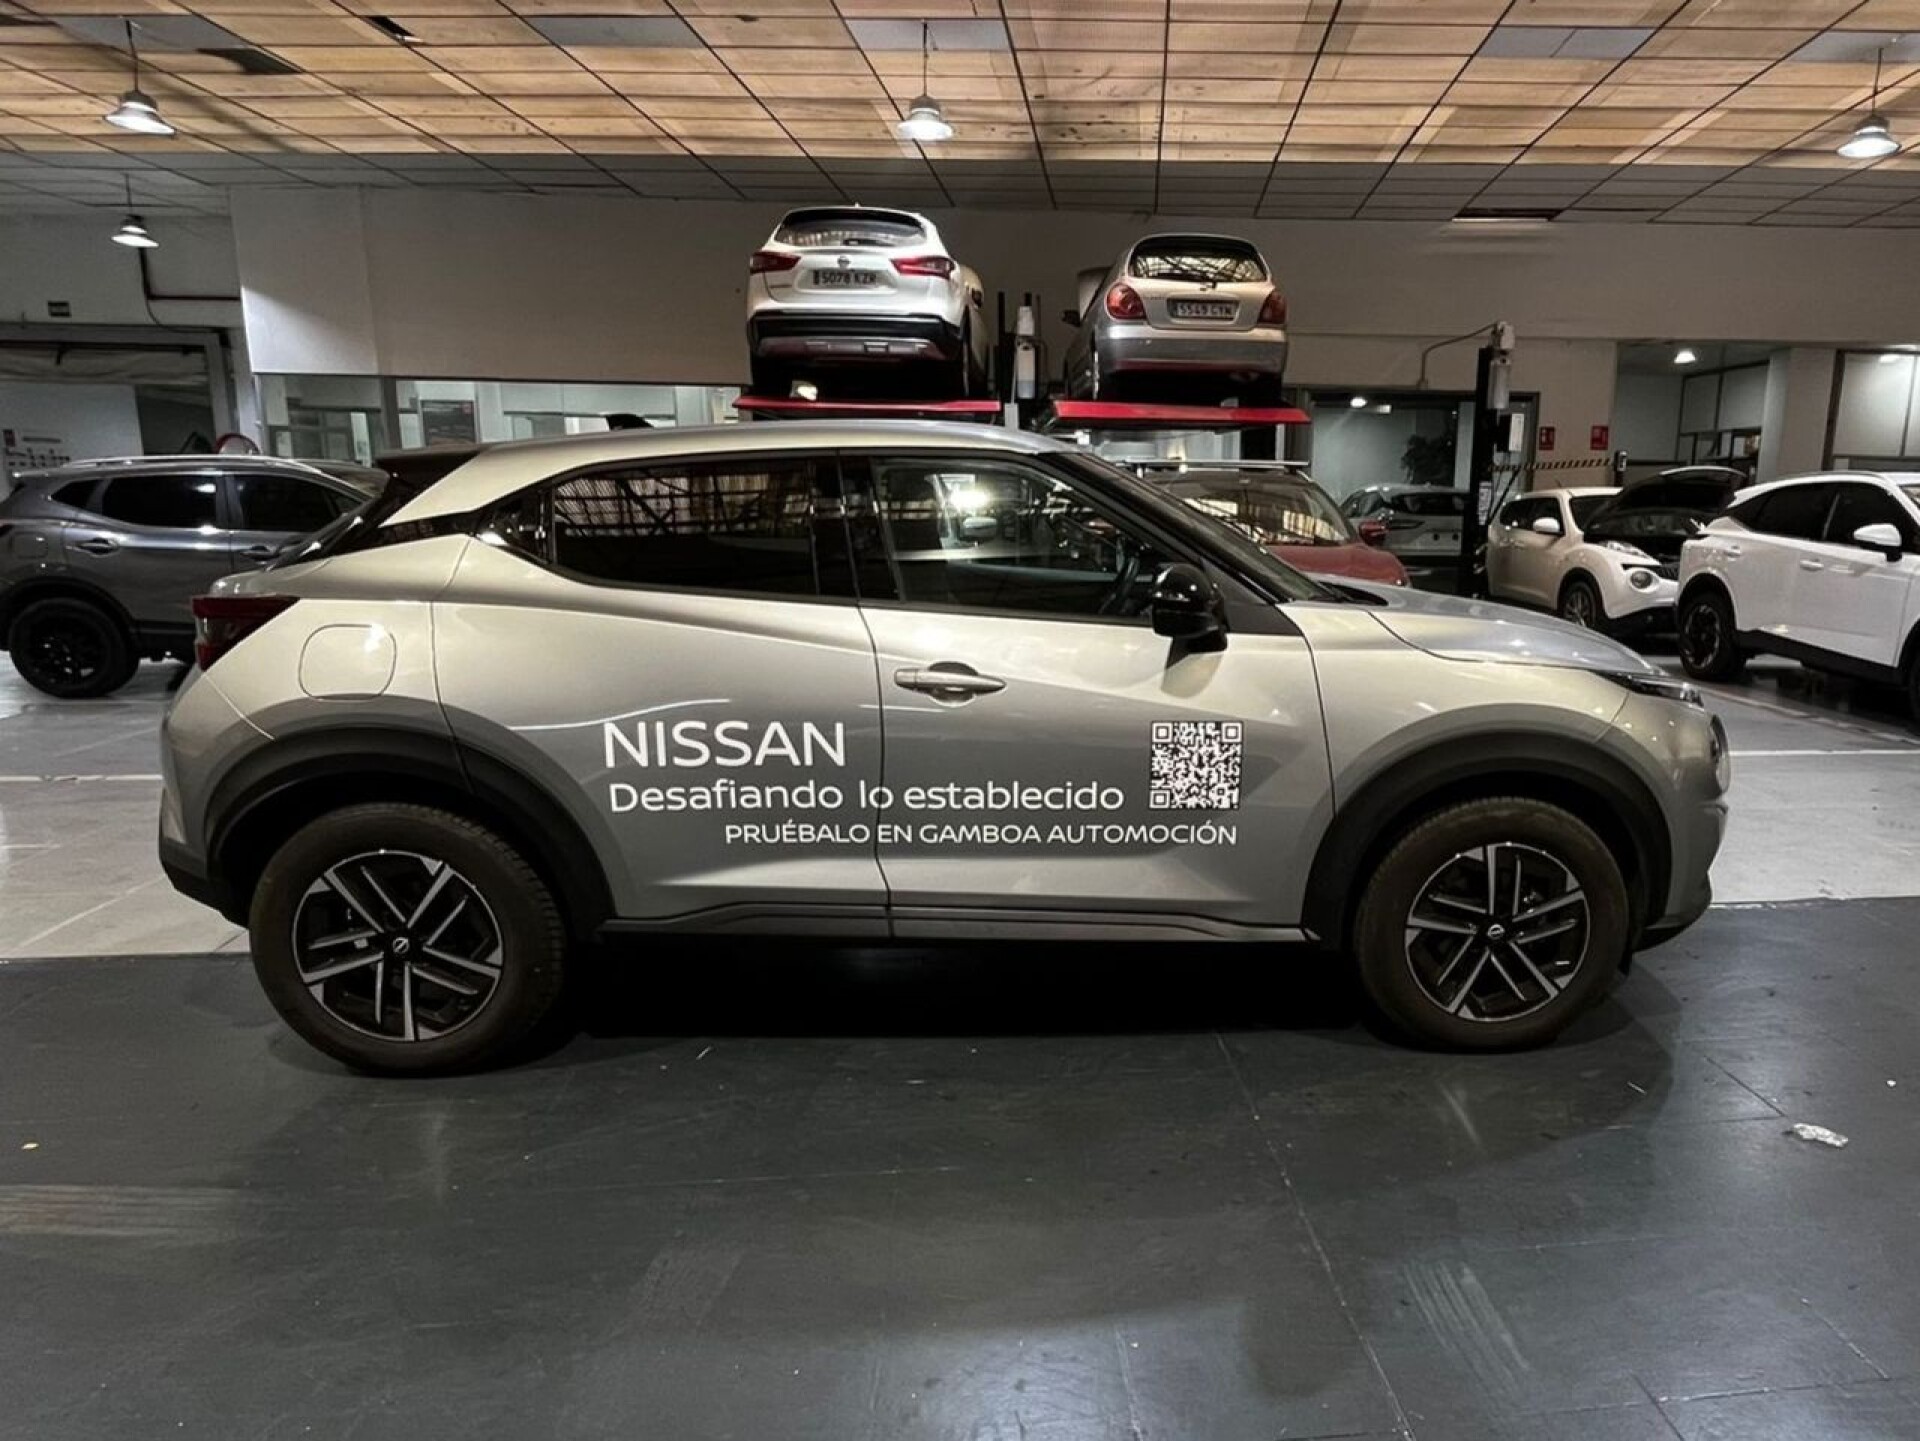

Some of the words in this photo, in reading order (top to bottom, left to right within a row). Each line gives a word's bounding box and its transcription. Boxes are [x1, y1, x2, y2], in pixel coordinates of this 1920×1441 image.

[604, 720, 847, 768] NISSAN
[609, 778, 844, 812] Desafiando
[859, 779, 893, 809] lo
[903, 780, 1125, 810] establecido
[725, 818, 871, 845] PRUÉBALO
[877, 824, 913, 844] EN
[918, 824, 1042, 844] GAMBOA
[1046, 818, 1237, 845] AUTOMOCIÓN
